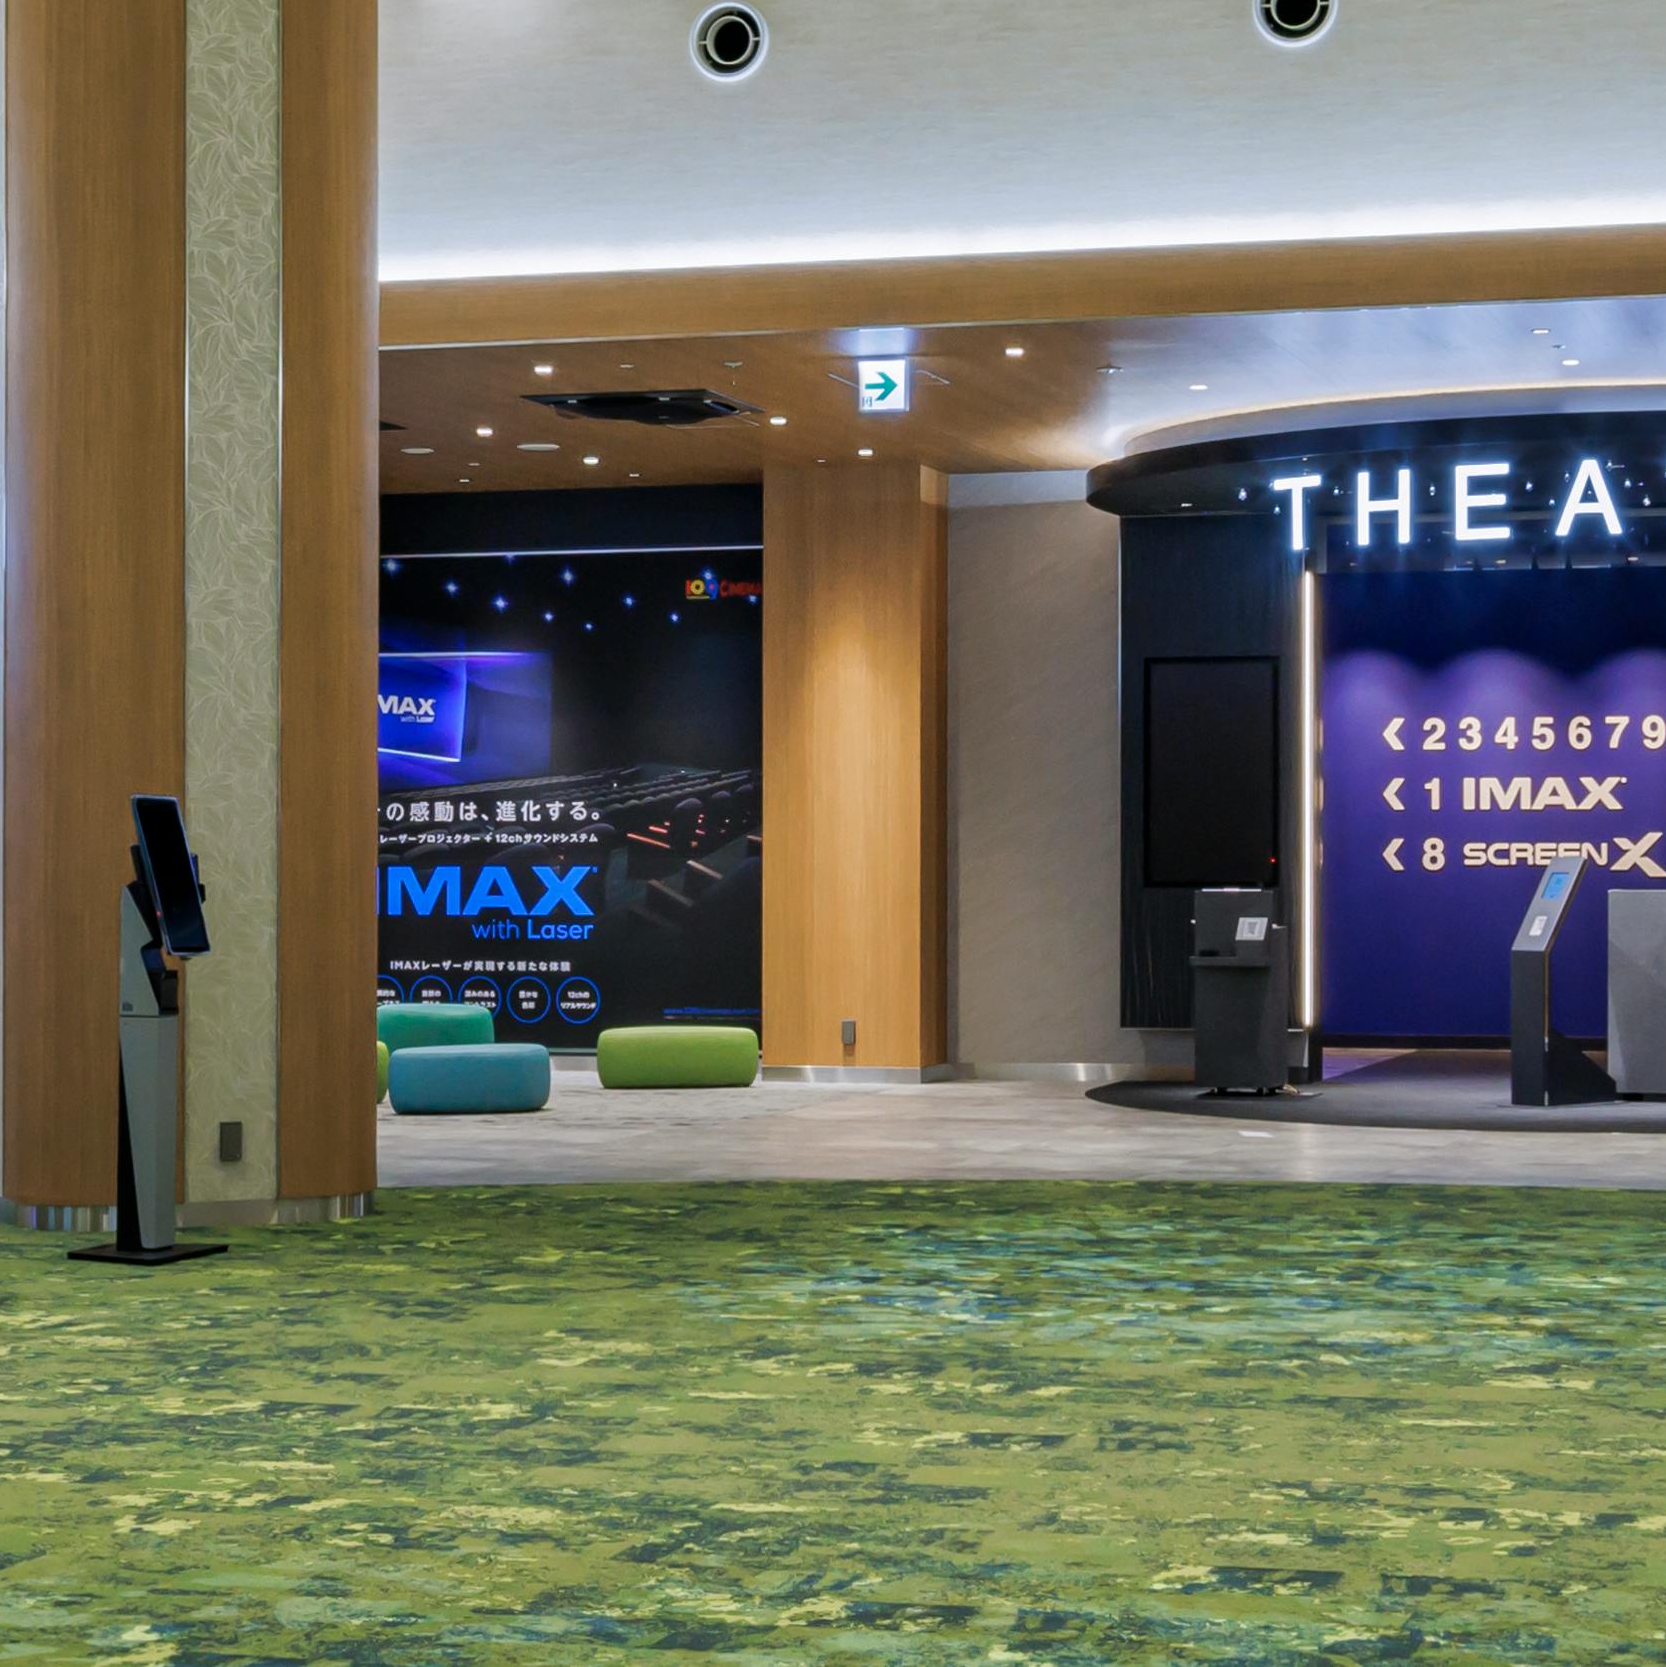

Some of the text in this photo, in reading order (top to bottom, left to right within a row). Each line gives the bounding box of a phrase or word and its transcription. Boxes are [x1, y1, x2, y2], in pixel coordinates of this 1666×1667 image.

[377, 800, 600, 822] の感動は、進化する。
[1463, 777, 1625, 811] IMAX
[1422, 837, 1445, 871] 8
[376, 865, 595, 916] MAX
[471, 918, 595, 940] with Laser
